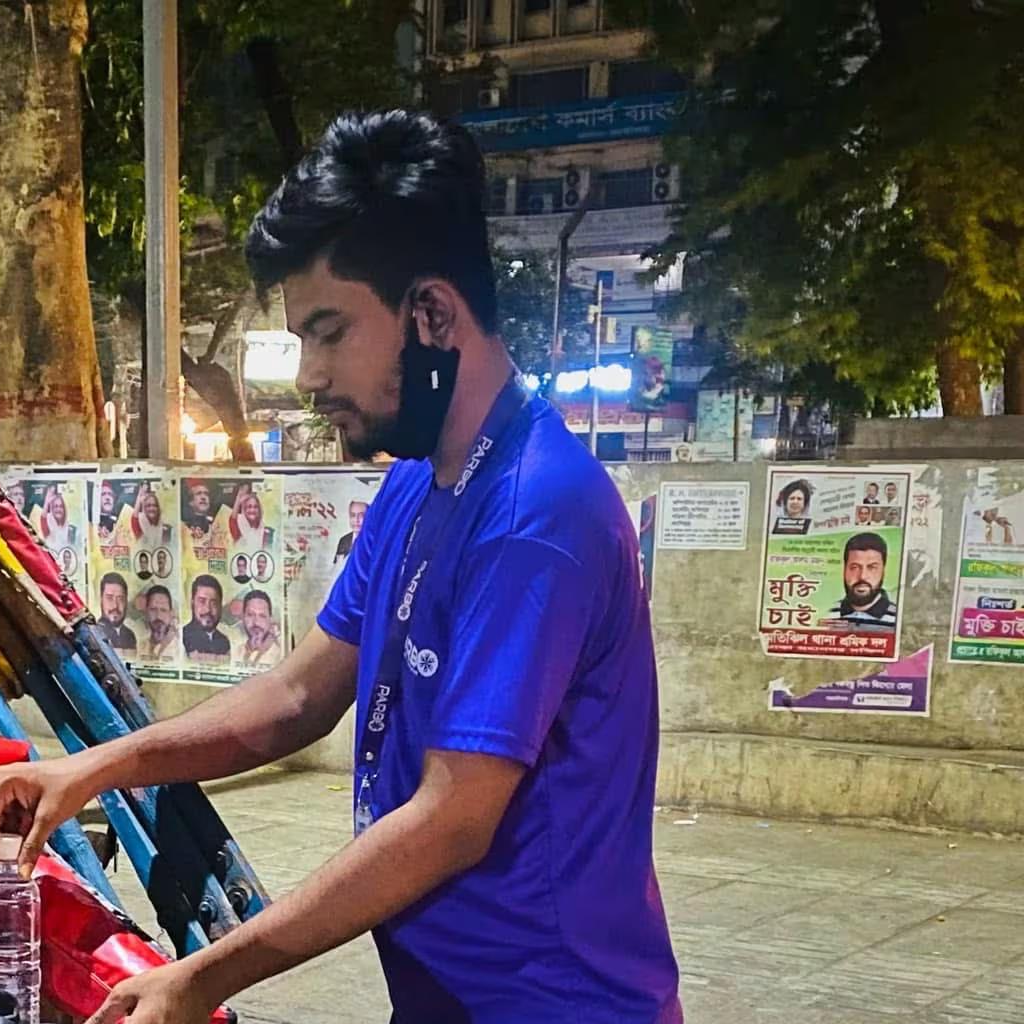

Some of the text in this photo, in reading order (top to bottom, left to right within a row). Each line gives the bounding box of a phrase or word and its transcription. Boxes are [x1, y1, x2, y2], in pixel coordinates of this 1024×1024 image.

[454, 436, 493, 496] PARBO
[767, 574, 820, 605] মুক্তি
[766, 604, 816, 627] চাই
[963, 614, 998, 637] মুক্তি
[811, 634, 837, 646] থানা
[839, 634, 869, 648] শ্রমিক
[869, 637, 888, 649] দল
[368, 684, 391, 733] PARBO
